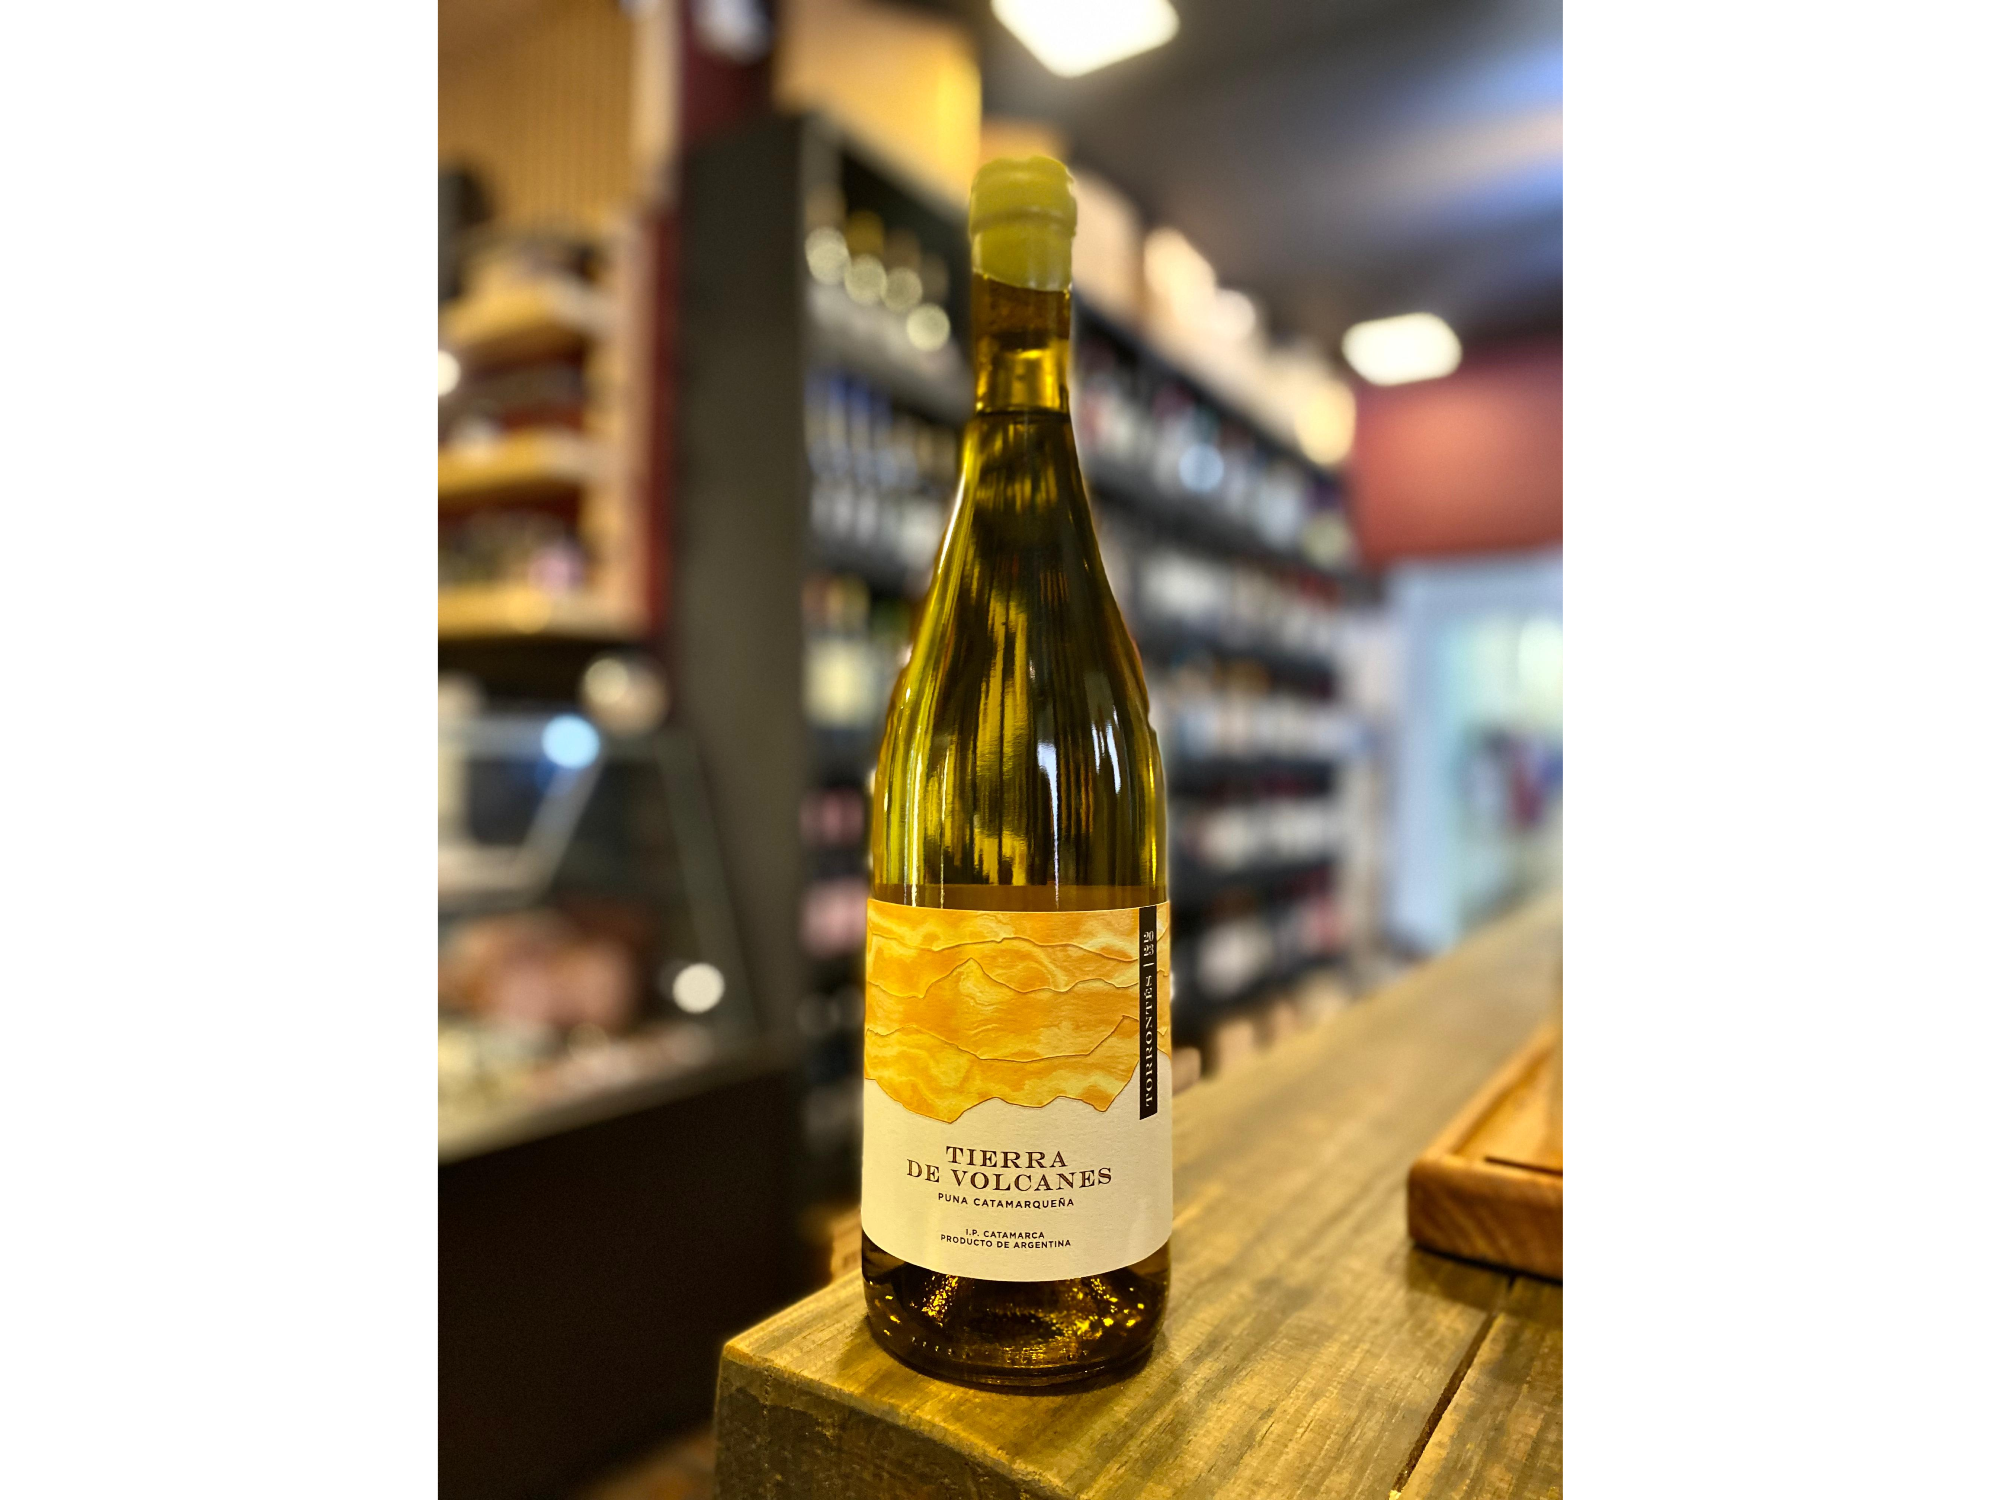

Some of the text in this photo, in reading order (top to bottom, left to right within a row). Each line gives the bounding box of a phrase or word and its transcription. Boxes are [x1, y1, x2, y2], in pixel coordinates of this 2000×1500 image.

[1143, 931, 1154, 943] 20
[1143, 944, 1154, 956] 23
[1144, 975, 1153, 1107] TORRONTÉS
[945, 1145, 1068, 1169] TIERRA
[907, 1158, 1112, 1192] DE VOLCANES
[938, 1192, 1075, 1209] PUNA CATAMARQUEÑA
[940, 1234, 1071, 1249] PRODUCTO DE ARGENTINA
[965, 1228, 1045, 1239] I.P. CATAMARCA
